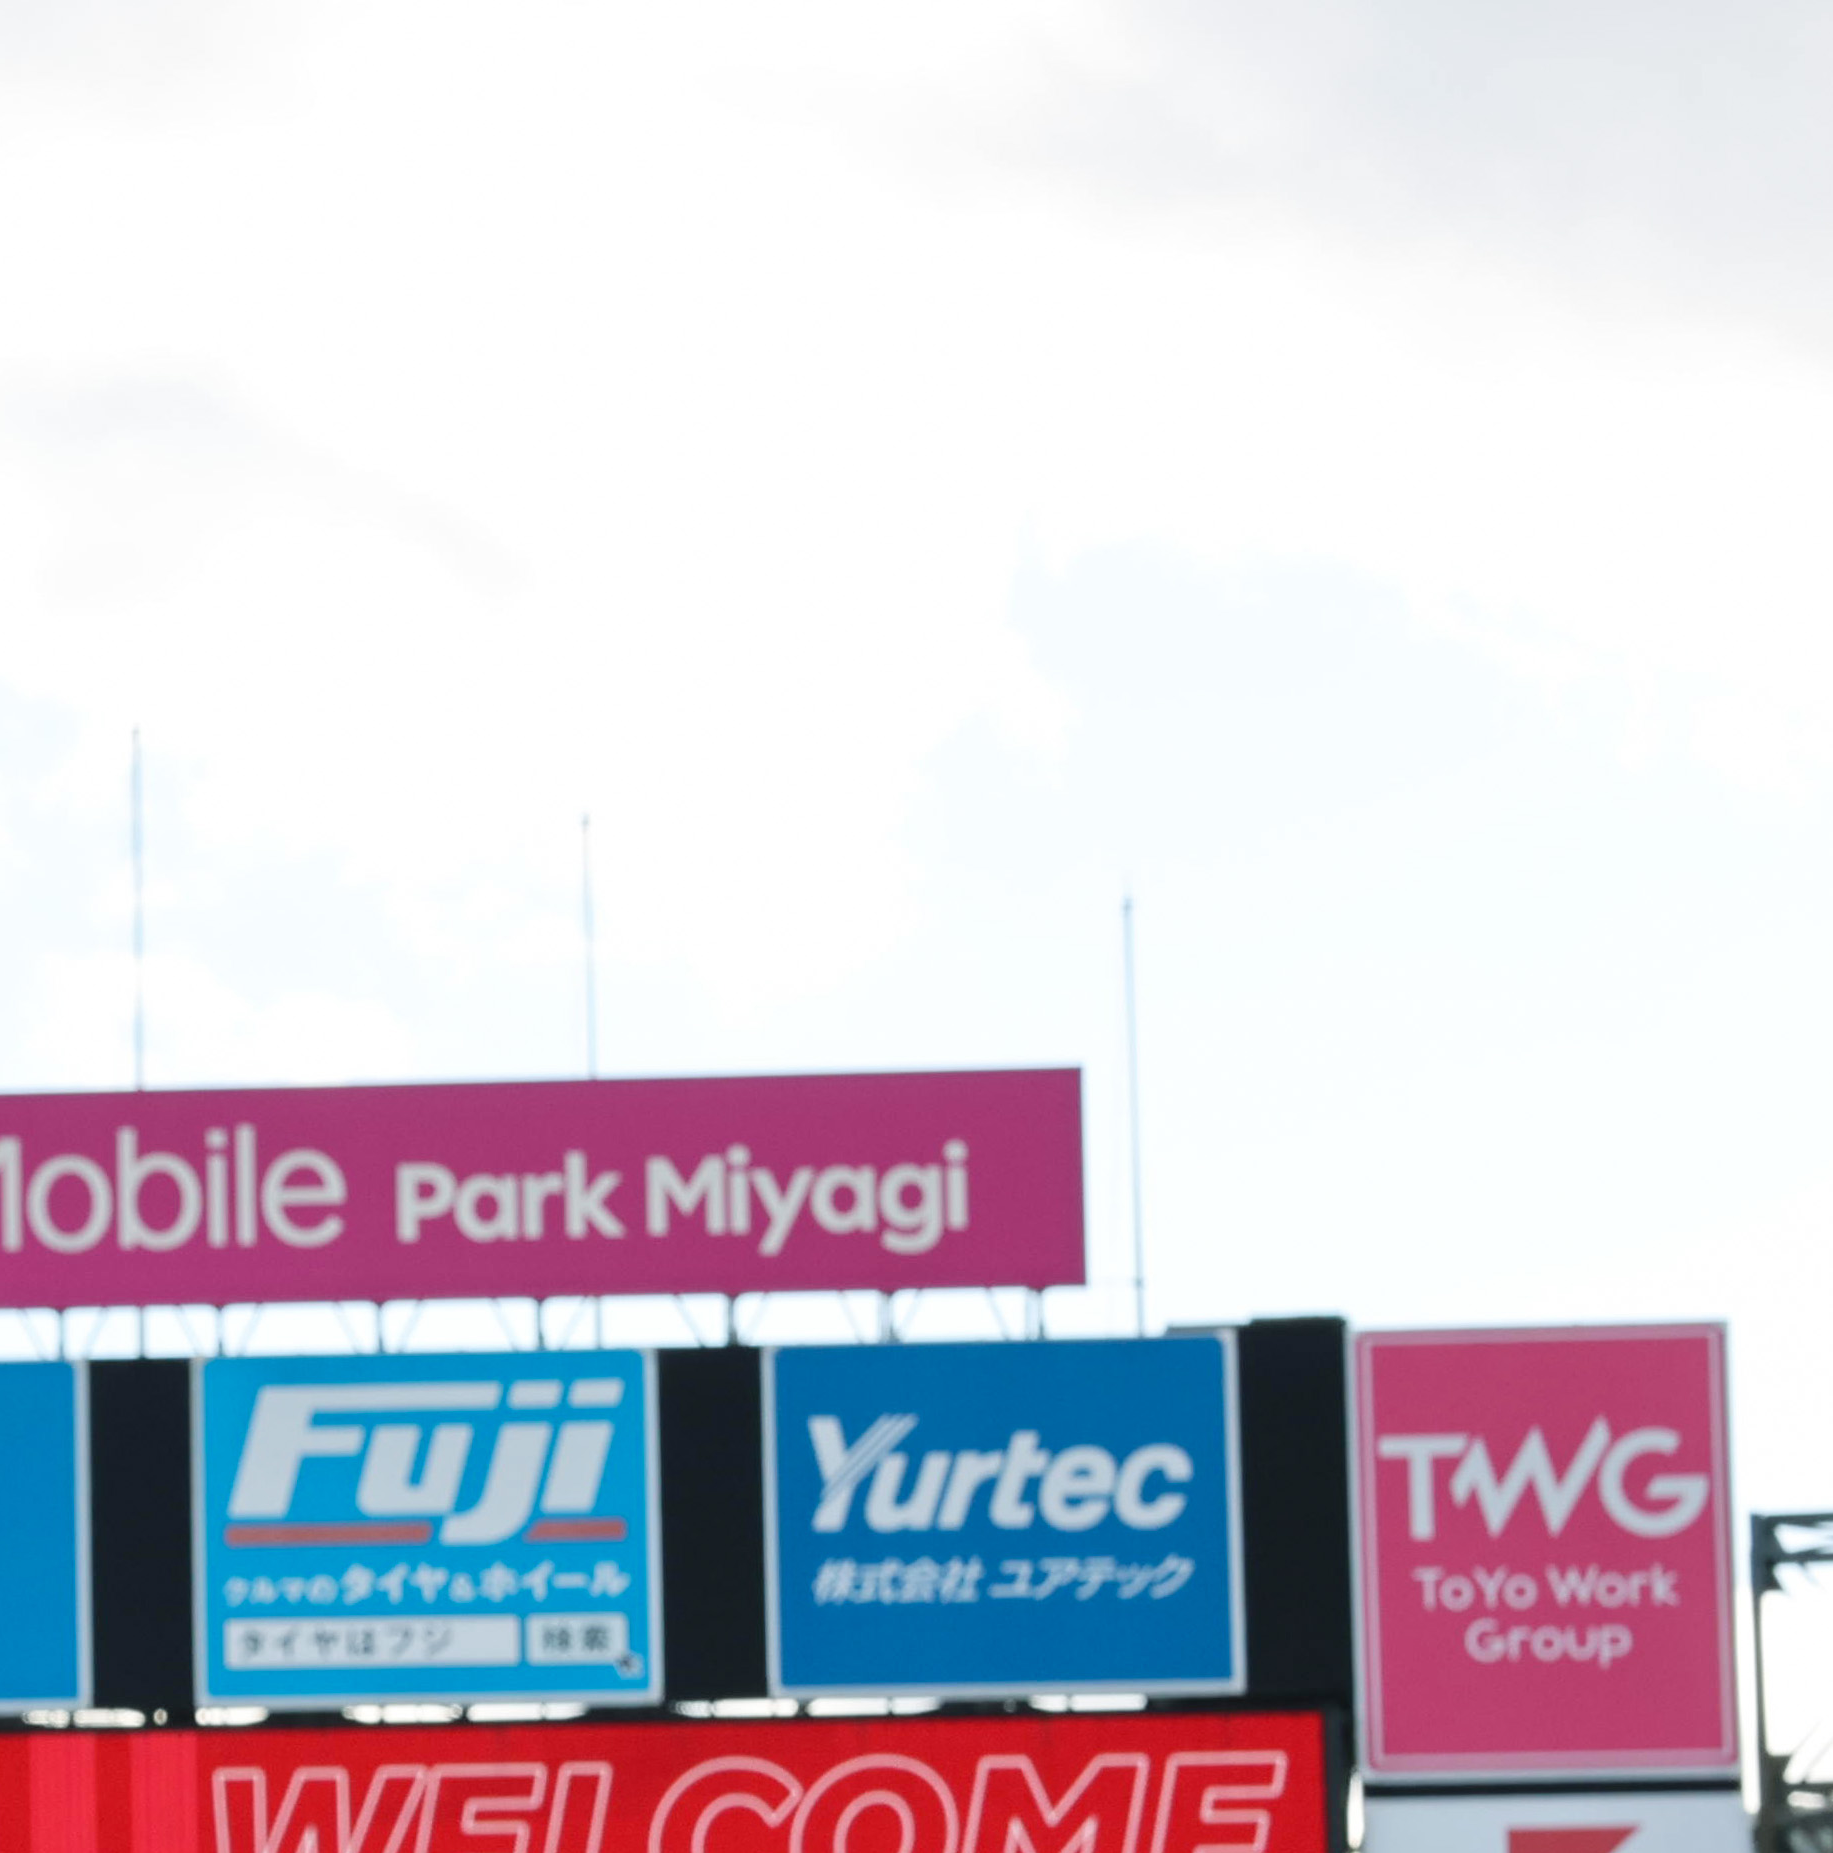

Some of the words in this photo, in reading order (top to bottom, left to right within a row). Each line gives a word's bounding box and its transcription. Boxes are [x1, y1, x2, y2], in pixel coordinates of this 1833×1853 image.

[396, 1150, 624, 1243] Park
[646, 1140, 970, 1256] Miyagi
[227, 1380, 625, 1546] Fuji
[808, 1412, 1194, 1534] Yurtec
[1377, 1414, 1710, 1541] TWG
[811, 1556, 985, 1606] 株式会社
[988, 1553, 1196, 1602] ユアテック
[1414, 1566, 1537, 1611] ToYo
[1546, 1562, 1678, 1608] Work
[1464, 1617, 1633, 1668] Group
